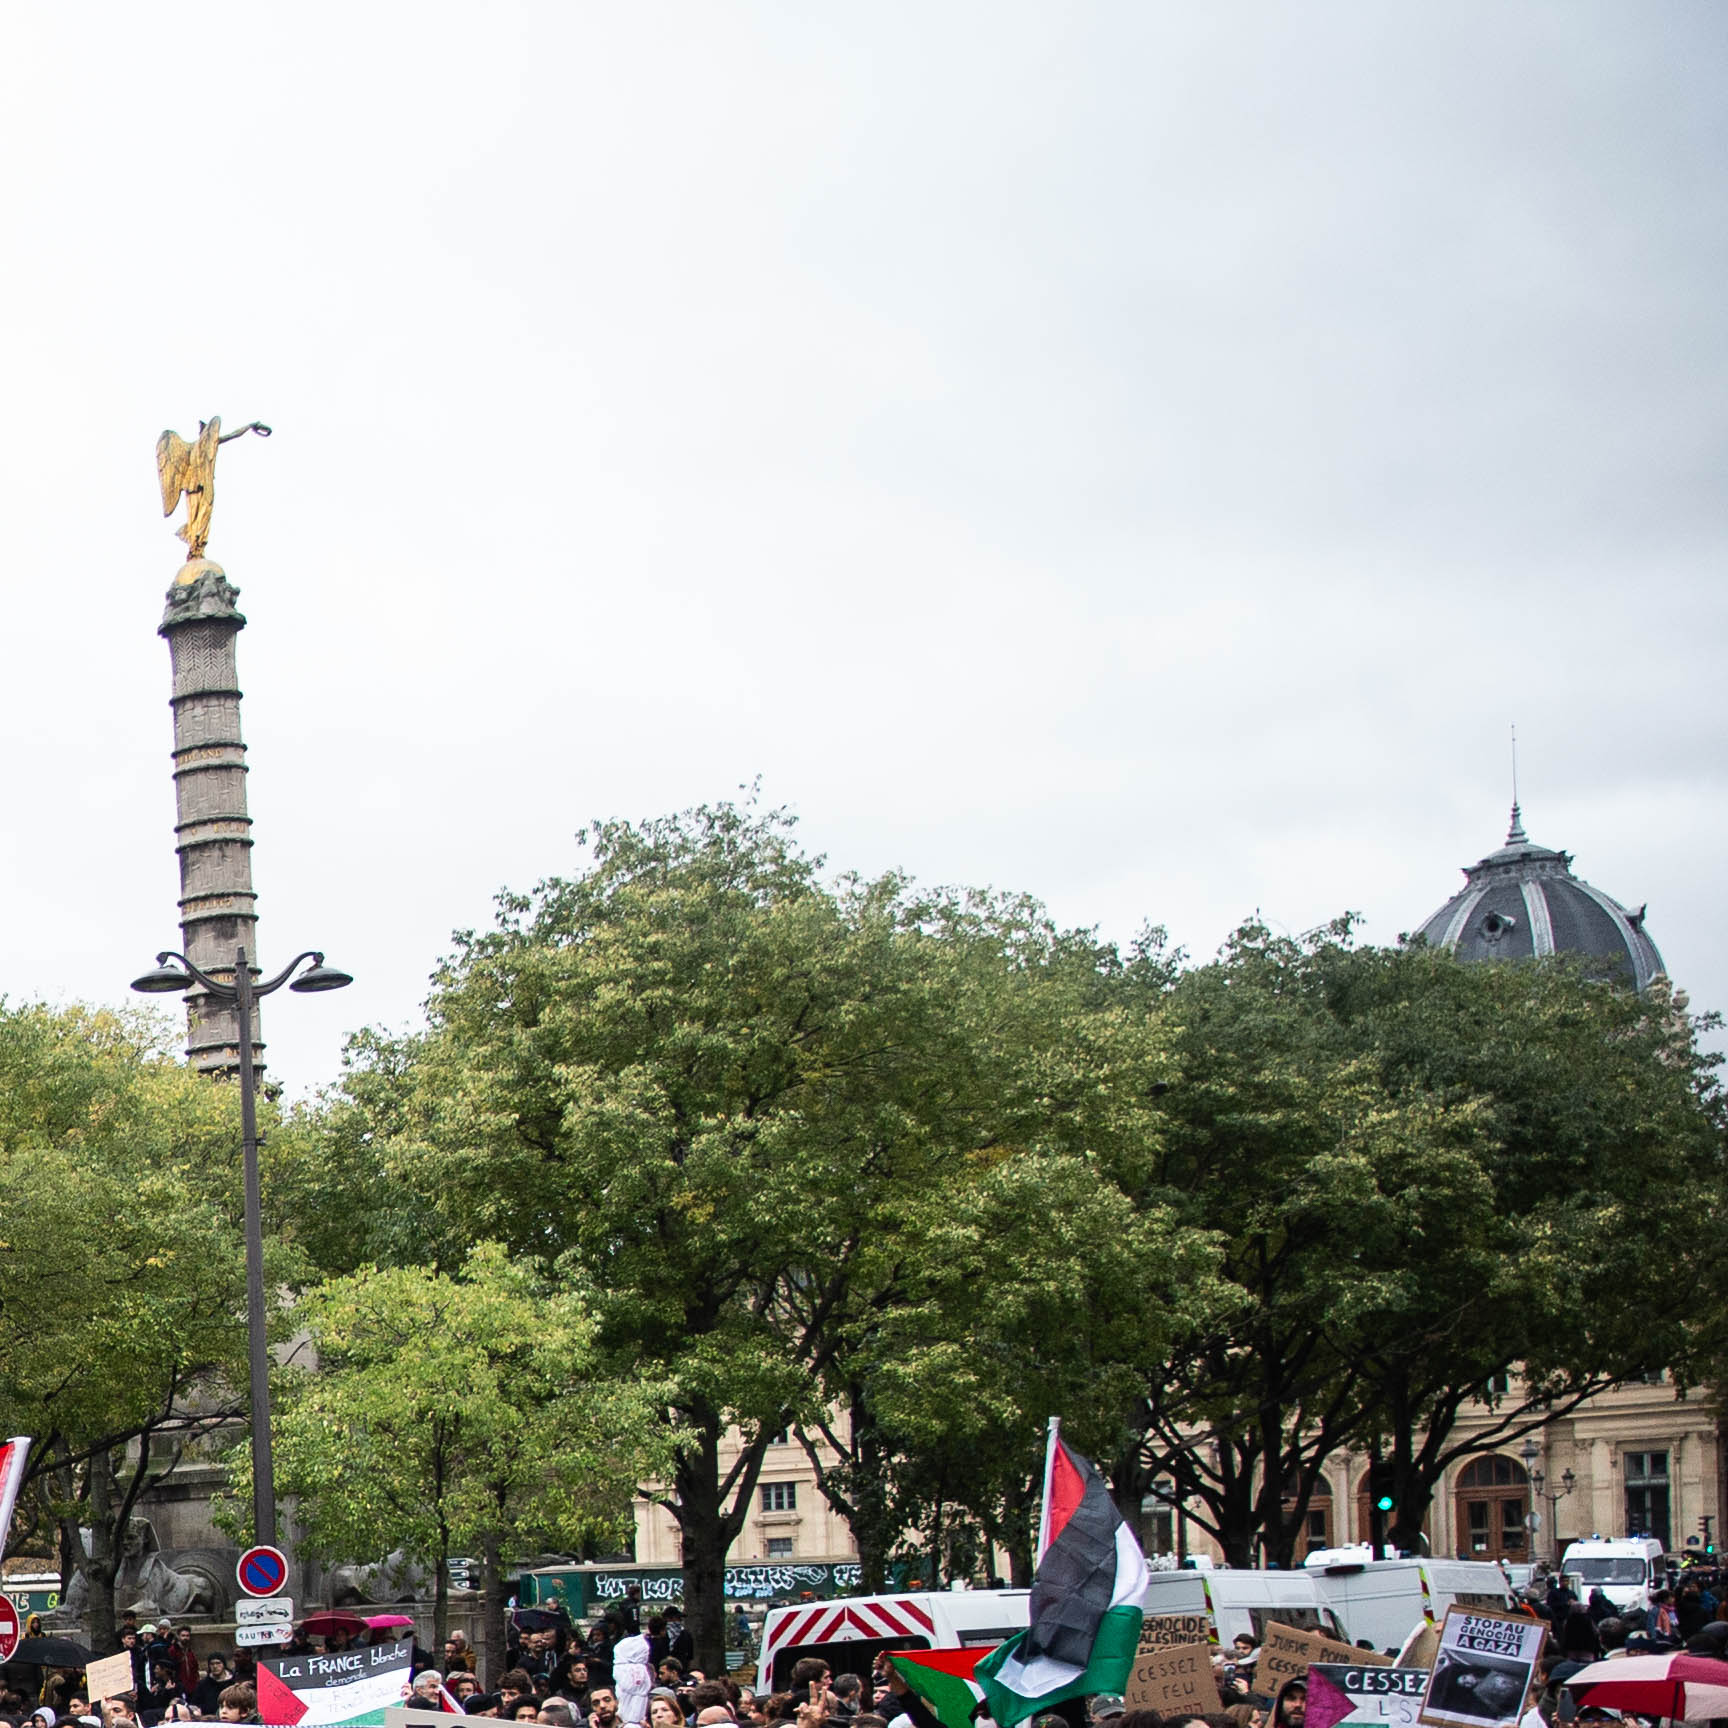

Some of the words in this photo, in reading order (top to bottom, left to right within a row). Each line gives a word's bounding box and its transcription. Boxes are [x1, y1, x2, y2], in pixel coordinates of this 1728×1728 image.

[1460, 1625, 1524, 1643] GENOCIDE
[1464, 1616, 1503, 1630] STOP
[1505, 1623, 1525, 1635] AU
[1457, 1635, 1471, 1648] A
[1472, 1638, 1520, 1656] GAZA
[279, 1662, 302, 1678] La
[307, 1655, 364, 1676] FRANCE
[370, 1643, 409, 1666] blanche
[1137, 1657, 1198, 1683] CESSEZ
[1268, 1656, 1305, 1676] CESSE
[325, 1668, 368, 1687] demande
[1345, 1671, 1428, 1694] CESSEZ
